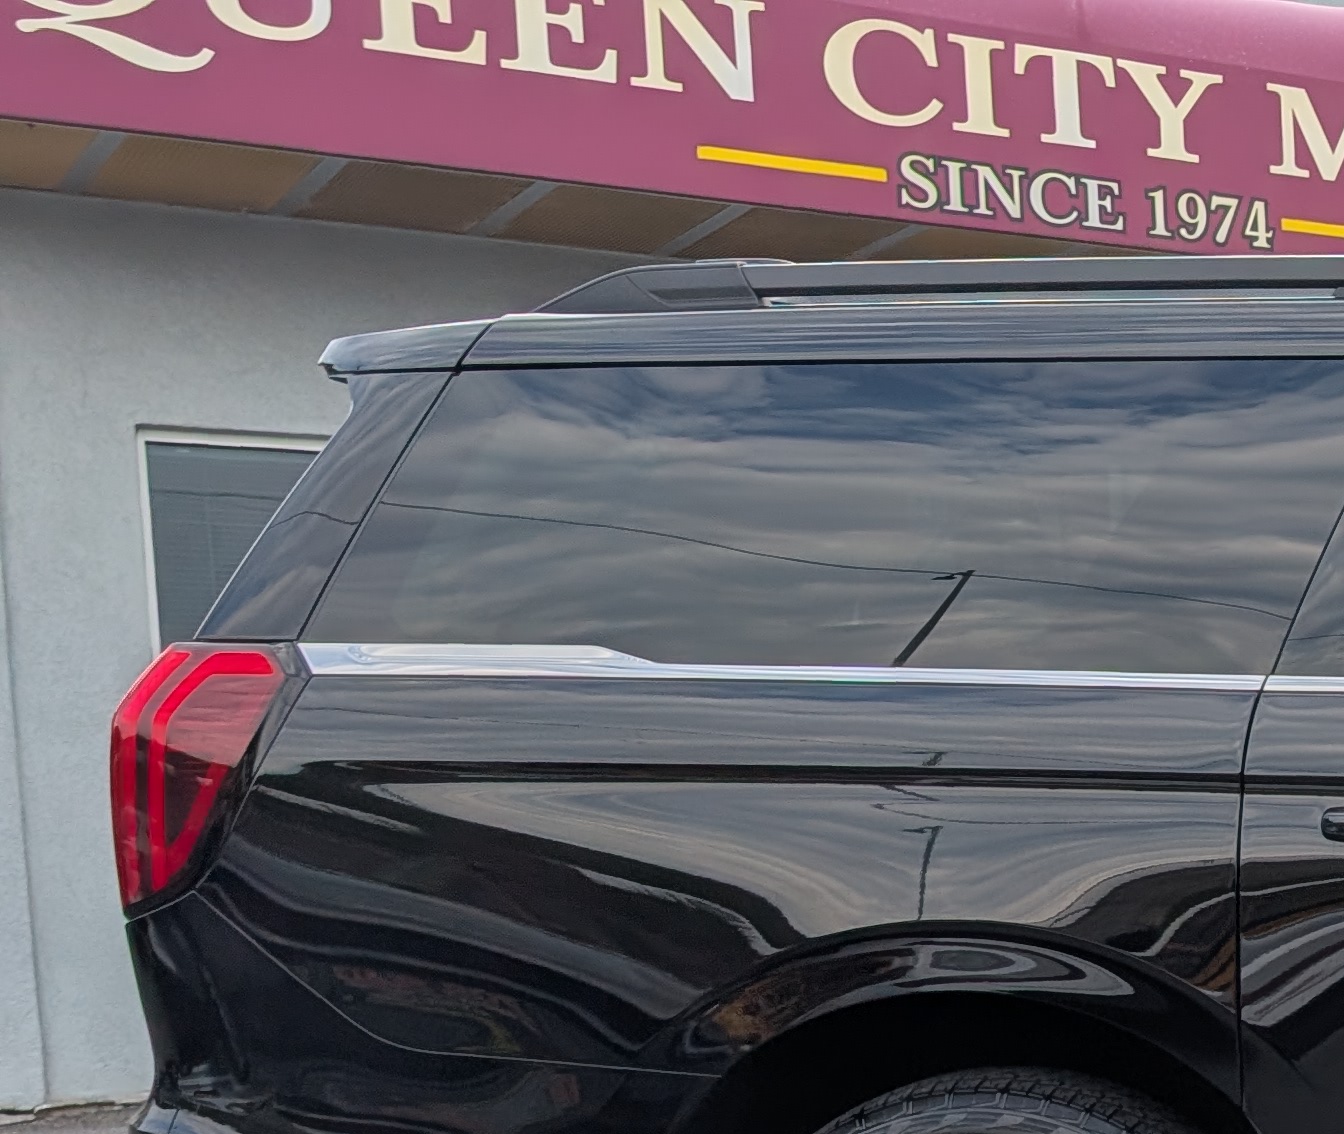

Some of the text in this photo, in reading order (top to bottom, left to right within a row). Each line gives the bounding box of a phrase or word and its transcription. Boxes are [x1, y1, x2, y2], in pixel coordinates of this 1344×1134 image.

[822, 18, 1223, 164] CITY
[898, 154, 1274, 250] SINCE 1974
